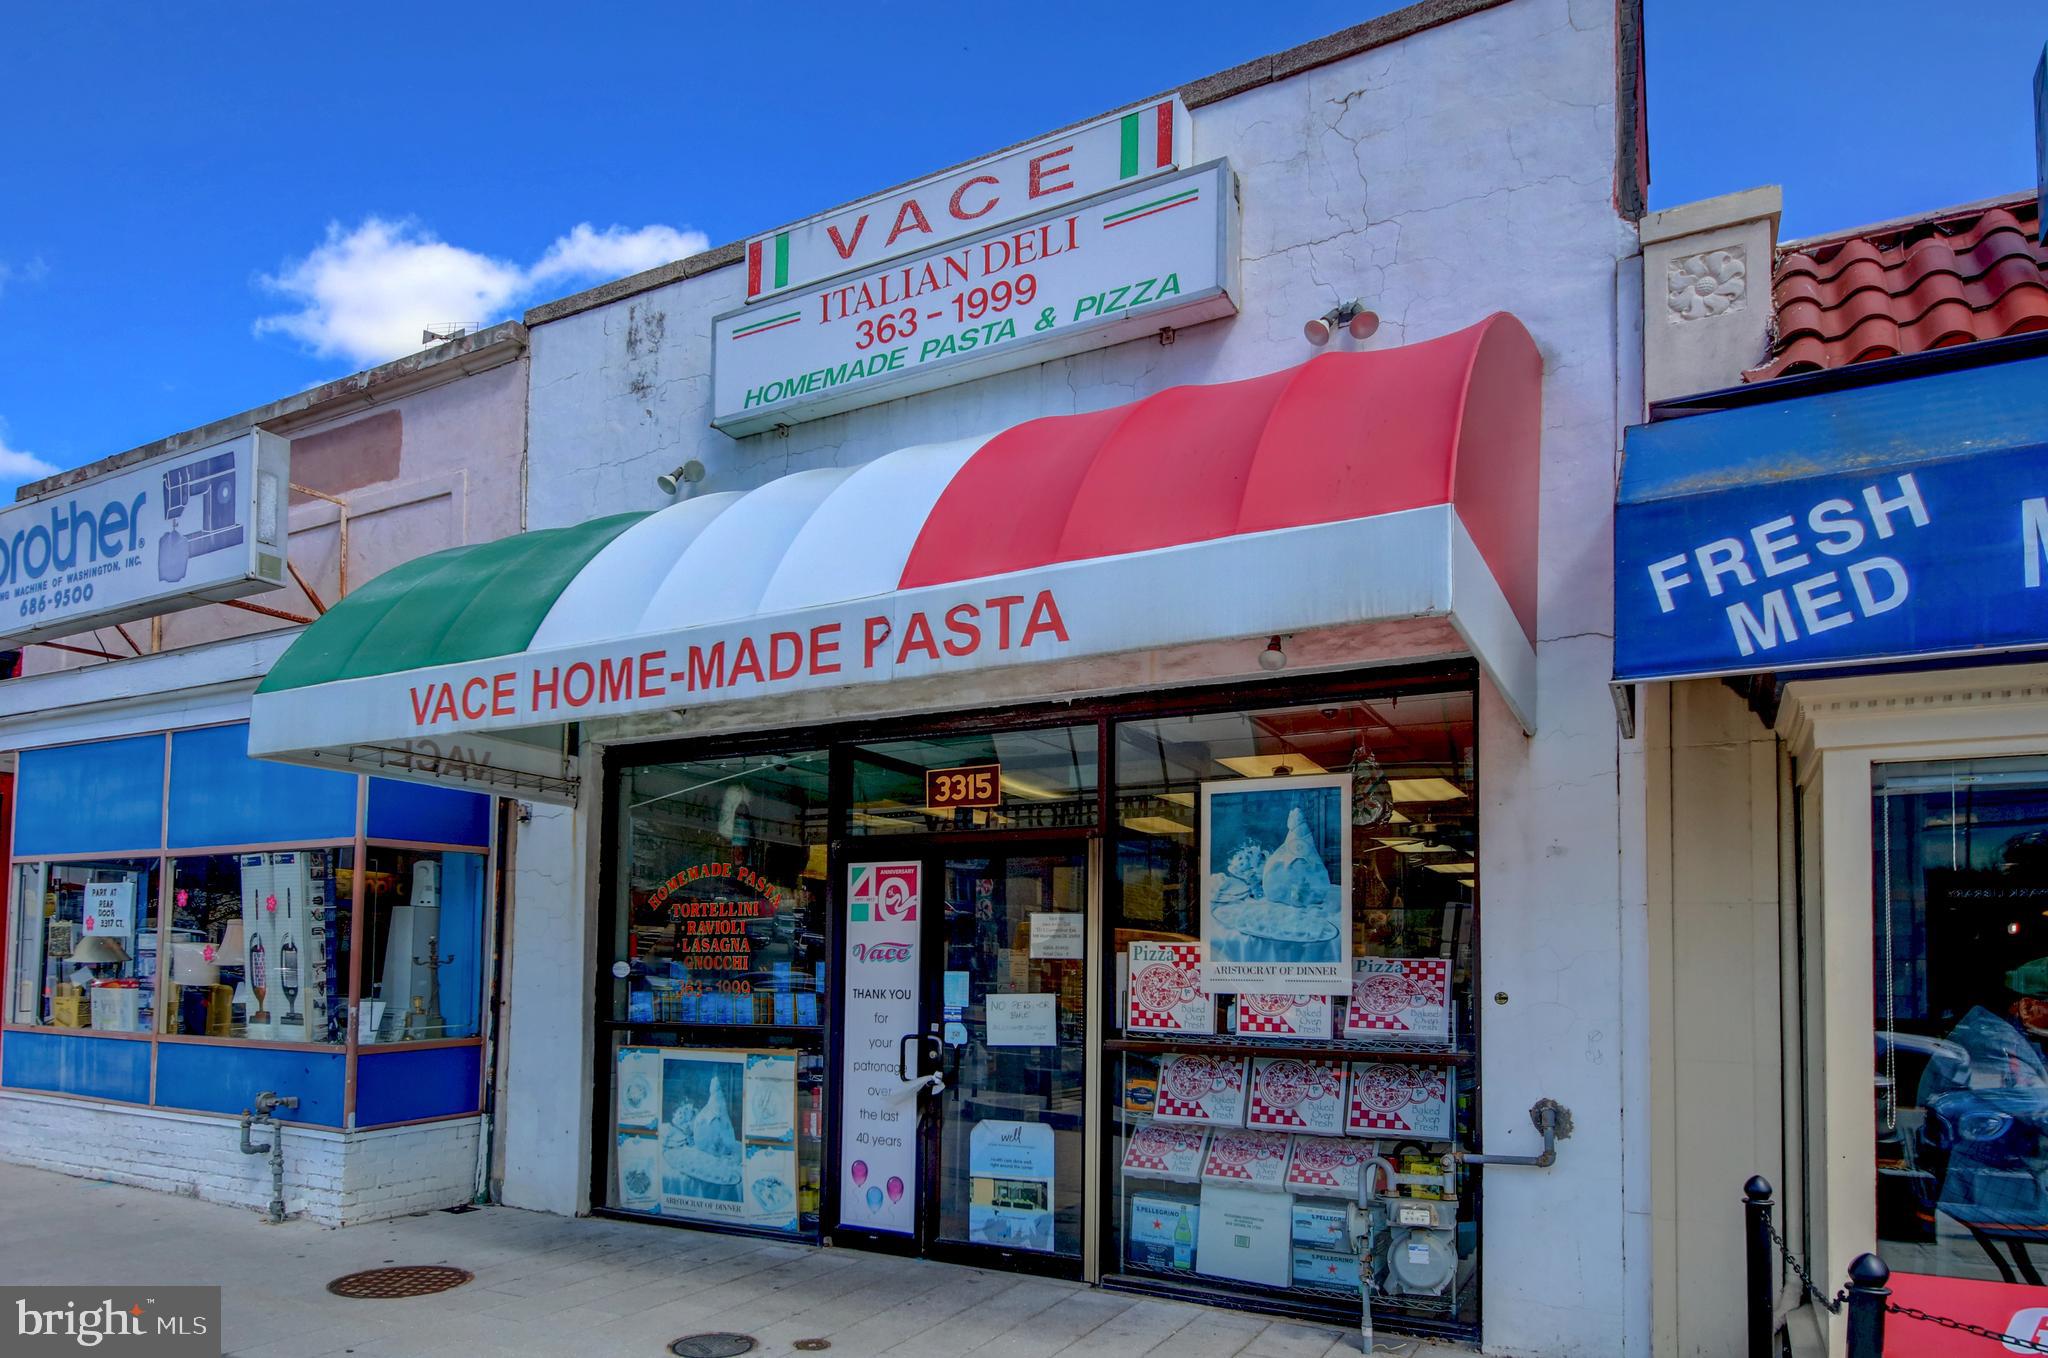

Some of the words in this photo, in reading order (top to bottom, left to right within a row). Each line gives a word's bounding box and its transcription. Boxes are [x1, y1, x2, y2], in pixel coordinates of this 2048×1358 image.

[826, 145, 1075, 261] VACE
[819, 249, 972, 325] ITALIAN
[981, 215, 1081, 277] DELI
[855, 307, 919, 351] 363
[952, 273, 1038, 324] 1999
[743, 347, 909, 410] HOMEMADE
[918, 317, 1017, 363] PASTA
[1034, 307, 1057, 333] &
[1073, 271, 1182, 323] PIZZA
[1647, 473, 1931, 614] FRESH
[14, 580, 48, 598] MACHINE
[52, 576, 63, 588] OF
[66, 561, 122, 585] WASHINGTON,
[20, 583, 94, 618] 686-9500
[1726, 556, 1911, 657] MED
[410, 672, 517, 727] VACE
[531, 622, 843, 712] HOME-MADE
[864, 588, 1070, 669] PASTA
[935, 773, 993, 803] 3315
[879, 868, 915, 876] ANNIVERSARY
[648, 863, 732, 911] HOMEMADE
[737, 866, 783, 908] PASTA
[672, 901, 759, 918] TORTELLINI
[686, 919, 746, 935] RAVIOLI
[682, 937, 751, 953] LASAGNA
[853, 942, 914, 964] Vace
[1133, 945, 1175, 962] Pizza
[684, 955, 749, 971] GNOCCHI
[1356, 959, 1404, 974] Pizza
[1214, 965, 1277, 975] ARISTOCRAT
[1278, 966, 1294, 975] OF
[1296, 966, 1338, 976] DINNER
[853, 988, 886, 1001] THANK
[888, 989, 912, 1001] YOU
[1181, 1005, 1205, 1014] Baked
[1295, 1006, 1322, 1017] Baked
[1411, 1008, 1440, 1018] Baked
[873, 1011, 888, 1024] for
[1184, 1013, 1206, 1023] Oven
[1299, 1016, 1322, 1026] Oven
[1414, 1017, 1439, 1026] Oven
[1183, 1020, 1205, 1029] Fresh
[1298, 1024, 1321, 1034] Fresh
[1412, 1023, 1437, 1031] Fresh
[868, 1038, 893, 1050] your
[867, 1087, 893, 1097] over
[1211, 1094, 1236, 1104] Baked
[1214, 1103, 1235, 1112] Oven
[1308, 1101, 1334, 1111] Baked
[1411, 1104, 1440, 1115] Baked
[859, 1108, 877, 1122] the
[880, 1109, 900, 1122] last
[1212, 1110, 1233, 1120] Fresh
[1311, 1110, 1334, 1121] Oven
[1415, 1113, 1440, 1125] Oven
[1310, 1118, 1333, 1128] Fresh
[1414, 1122, 1439, 1132] Fresh
[856, 1133, 870, 1146] 40
[871, 1136, 902, 1149] years
[1001, 1126, 1022, 1144] well
[664, 1197, 703, 1209] ARISTOCRAT
[715, 1203, 742, 1213] DINNER
[1136, 1206, 1180, 1217] S.PELLEGRINO
[1312, 1254, 1354, 1264] S.PELLEGRINO
